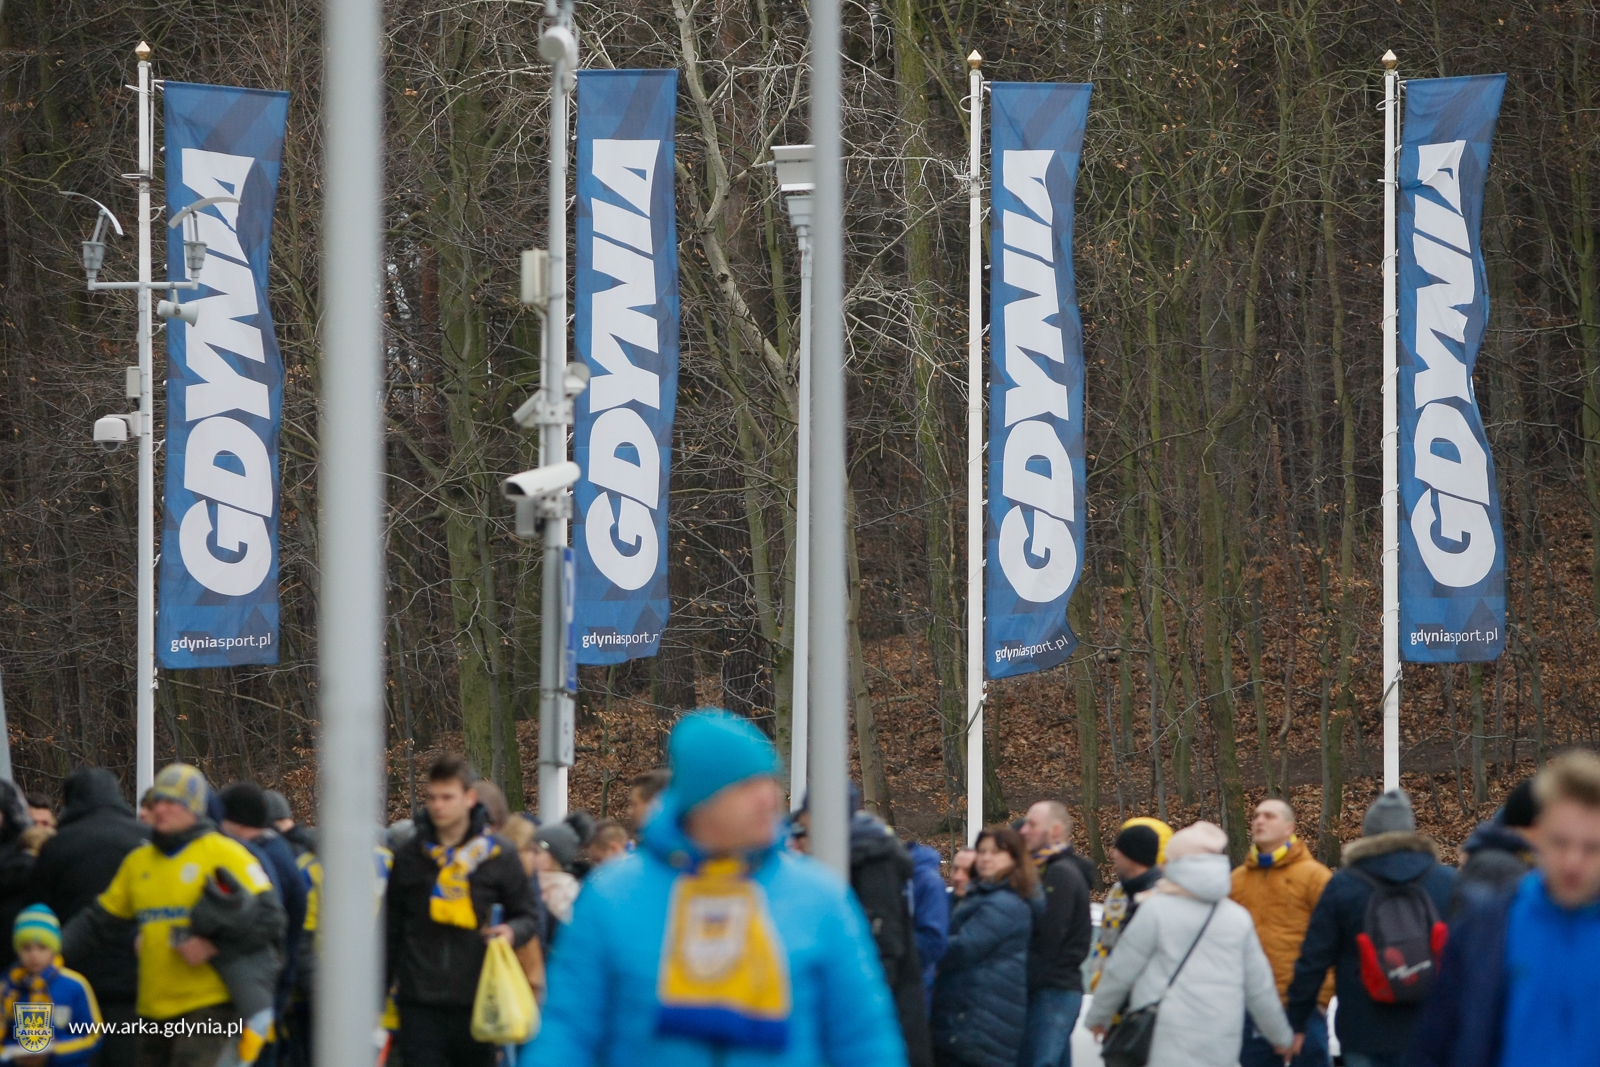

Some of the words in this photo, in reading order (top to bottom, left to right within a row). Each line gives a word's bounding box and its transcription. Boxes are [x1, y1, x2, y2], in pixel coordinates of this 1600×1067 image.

[179, 147, 273, 597] GDYNIA
[586, 139, 660, 590] GDYNIA
[999, 150, 1077, 602] GDYNIA
[1411, 140, 1496, 587] GDYNIA
[170, 632, 271, 653] gdyniasport.pl
[995, 634, 1069, 663] gdyniasport.pl
[1410, 627, 1498, 646] gdyniasport.pl
